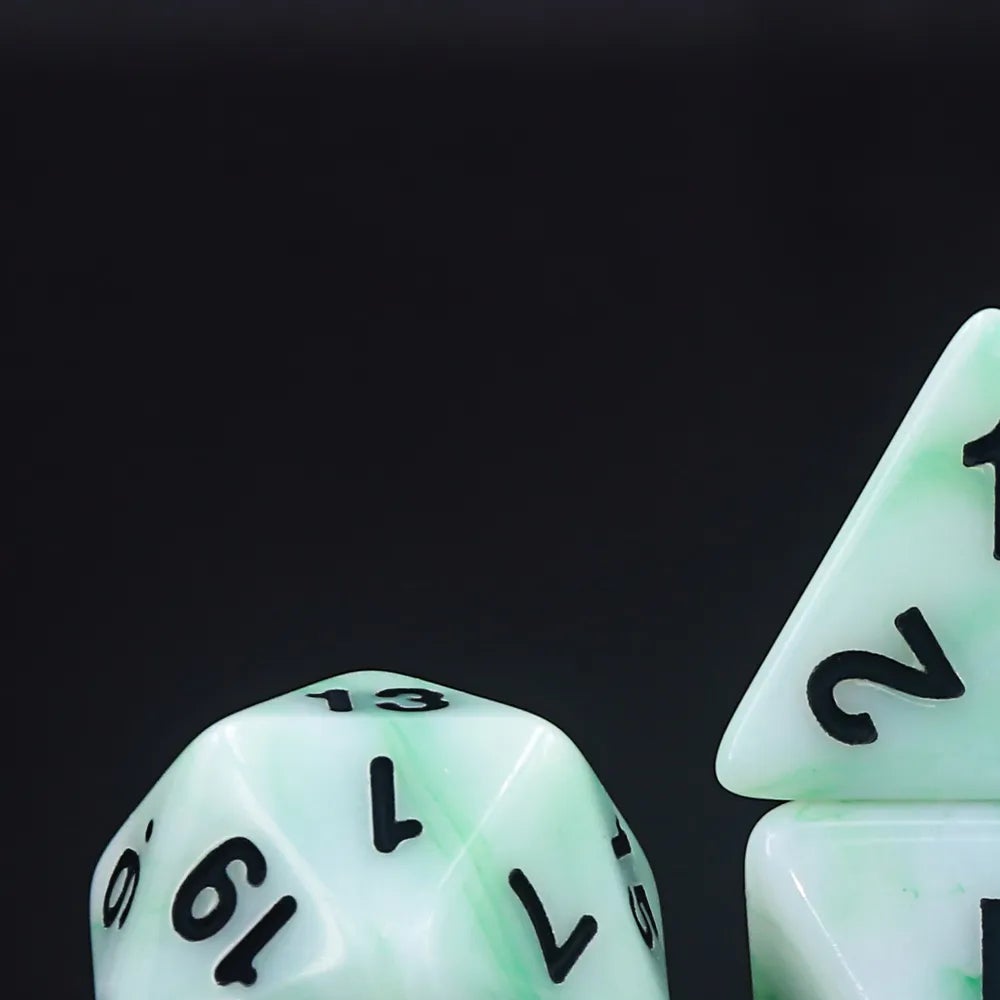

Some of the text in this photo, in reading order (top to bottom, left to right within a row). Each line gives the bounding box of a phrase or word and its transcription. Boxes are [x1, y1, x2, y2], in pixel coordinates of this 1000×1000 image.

[306, 688, 449, 713] 13
[807, 607, 965, 745] 2
[370, 756, 423, 853] 1
[172, 837, 298, 987] 19
[509, 869, 597, 984] 7
